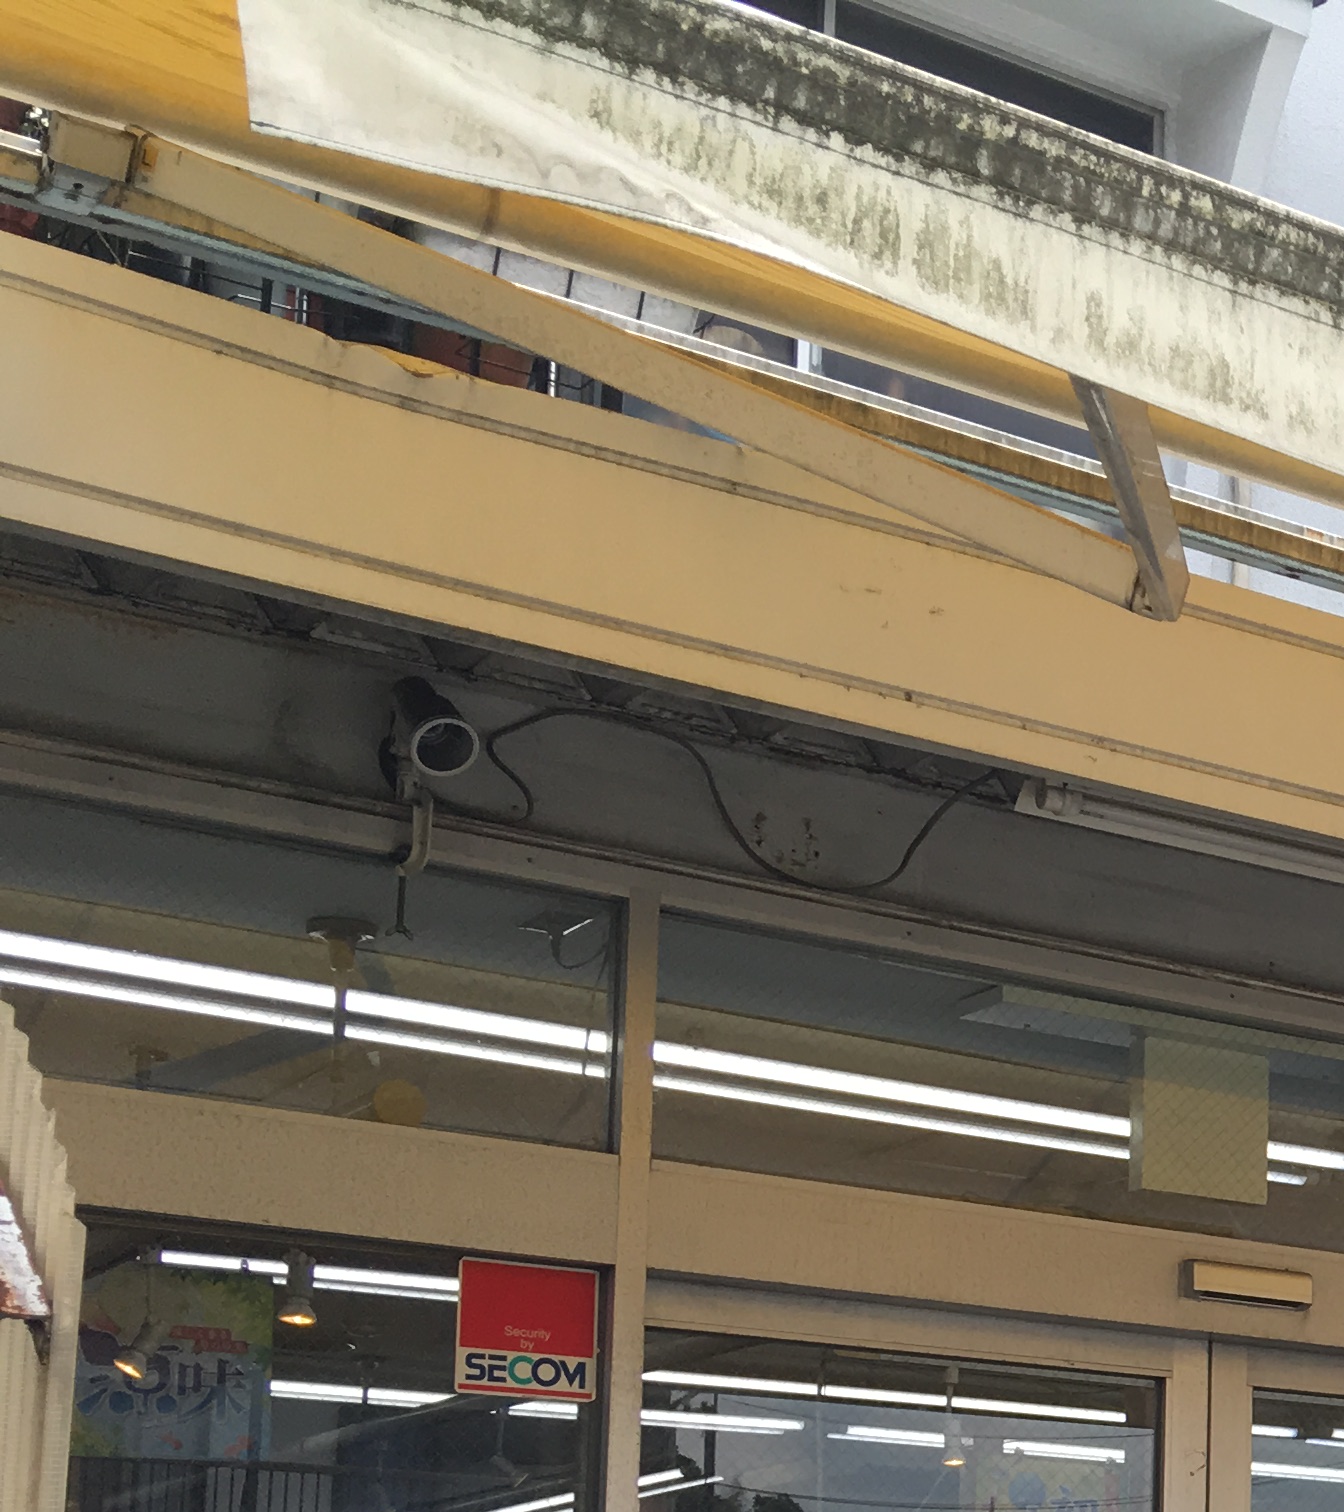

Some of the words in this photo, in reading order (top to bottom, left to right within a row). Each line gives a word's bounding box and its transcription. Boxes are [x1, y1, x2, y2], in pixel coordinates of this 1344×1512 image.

[504, 1325, 551, 1341] Security
[520, 1339, 534, 1351] by
[465, 1352, 587, 1390] SECOM
